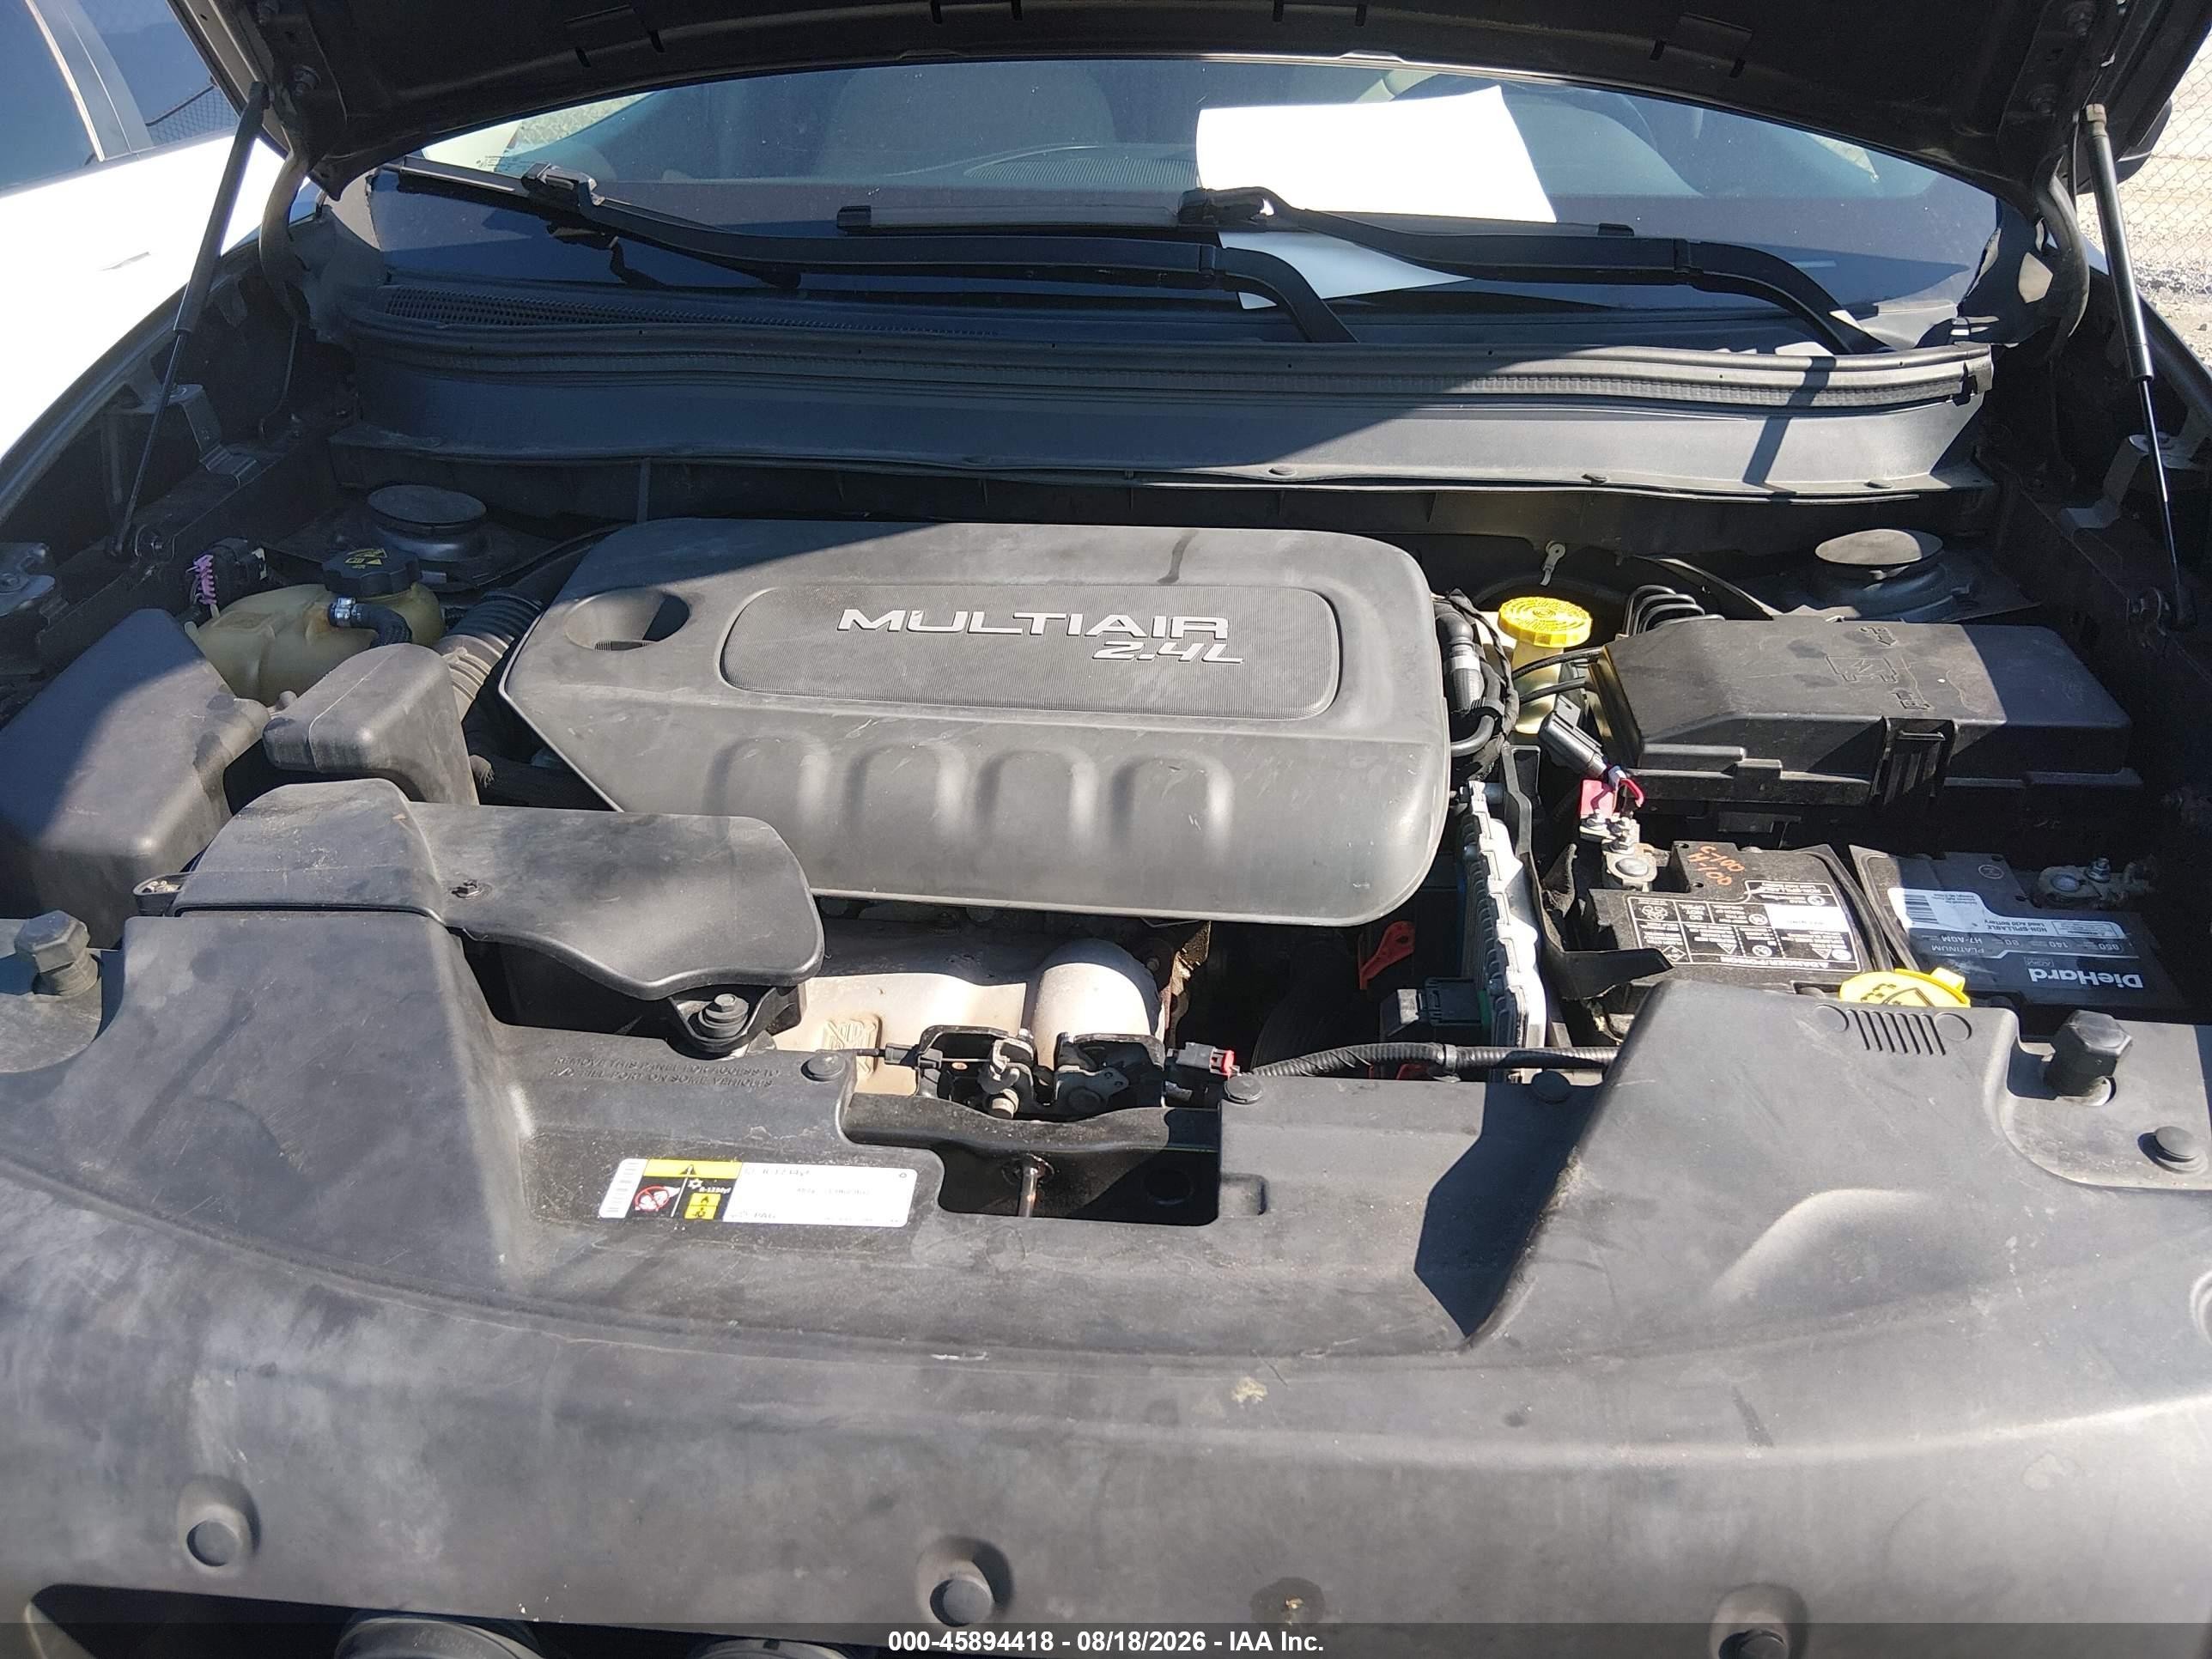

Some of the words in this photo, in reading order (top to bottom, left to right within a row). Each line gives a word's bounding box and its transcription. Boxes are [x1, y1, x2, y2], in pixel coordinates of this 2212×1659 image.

[837, 608, 1230, 640] MULTIAIR
[1092, 641, 1244, 664] 2.4L
[1931, 945, 1984, 954] PLATINUM
[2027, 968, 2144, 988] DieHard
